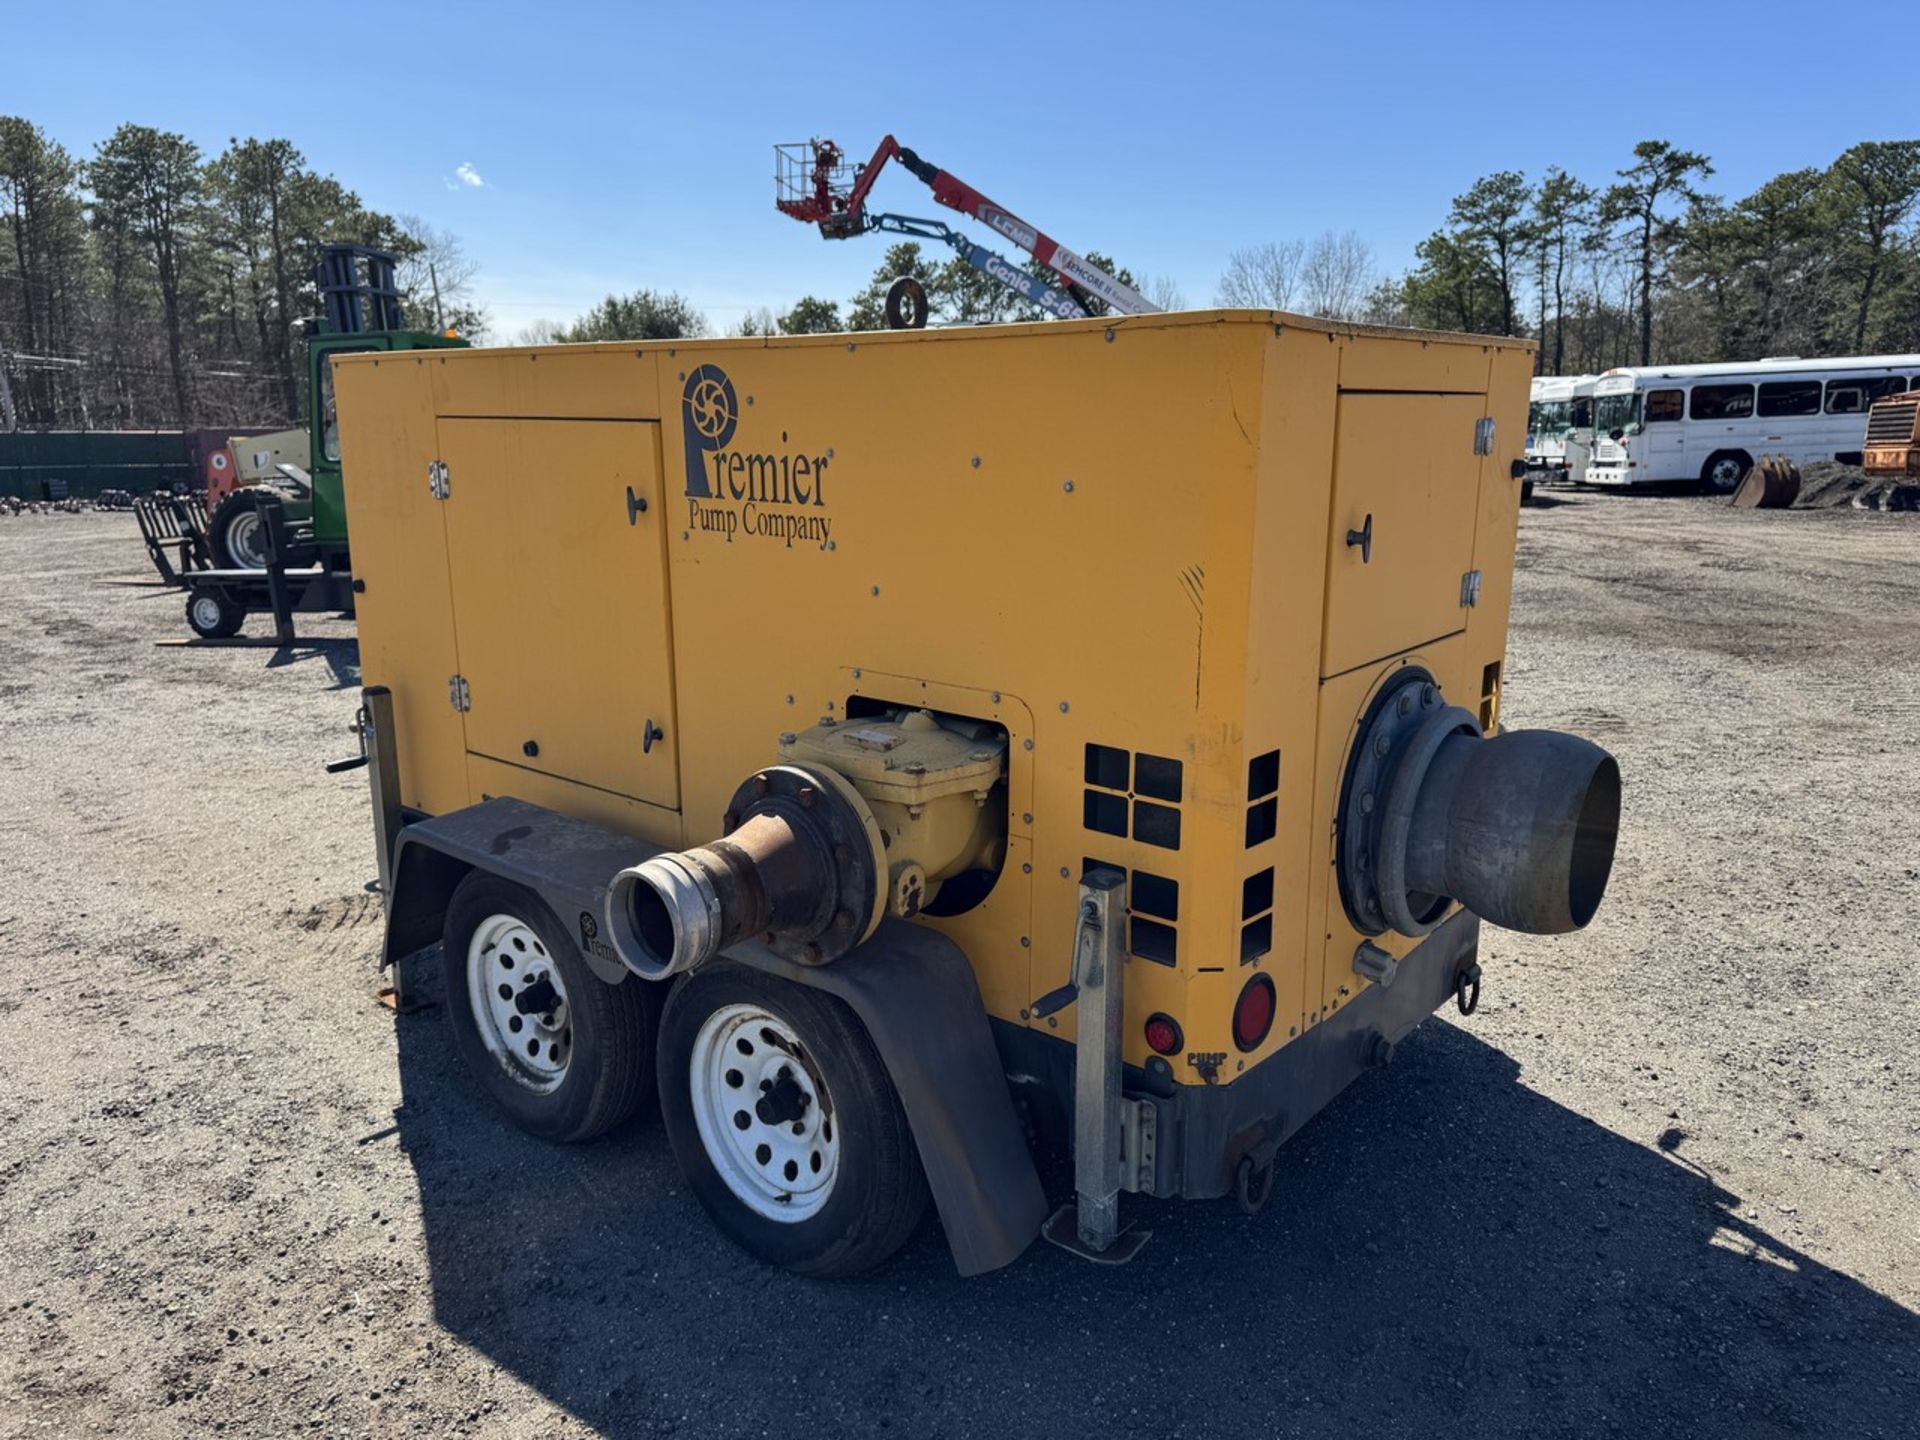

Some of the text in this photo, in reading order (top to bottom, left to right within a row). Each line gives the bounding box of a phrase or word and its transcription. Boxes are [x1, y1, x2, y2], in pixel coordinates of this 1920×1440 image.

[985, 257, 1031, 297] Genie
[682, 363, 829, 506] Premier
[688, 499, 831, 551] Pump Company
[1187, 1052, 1228, 1066] PUMP
